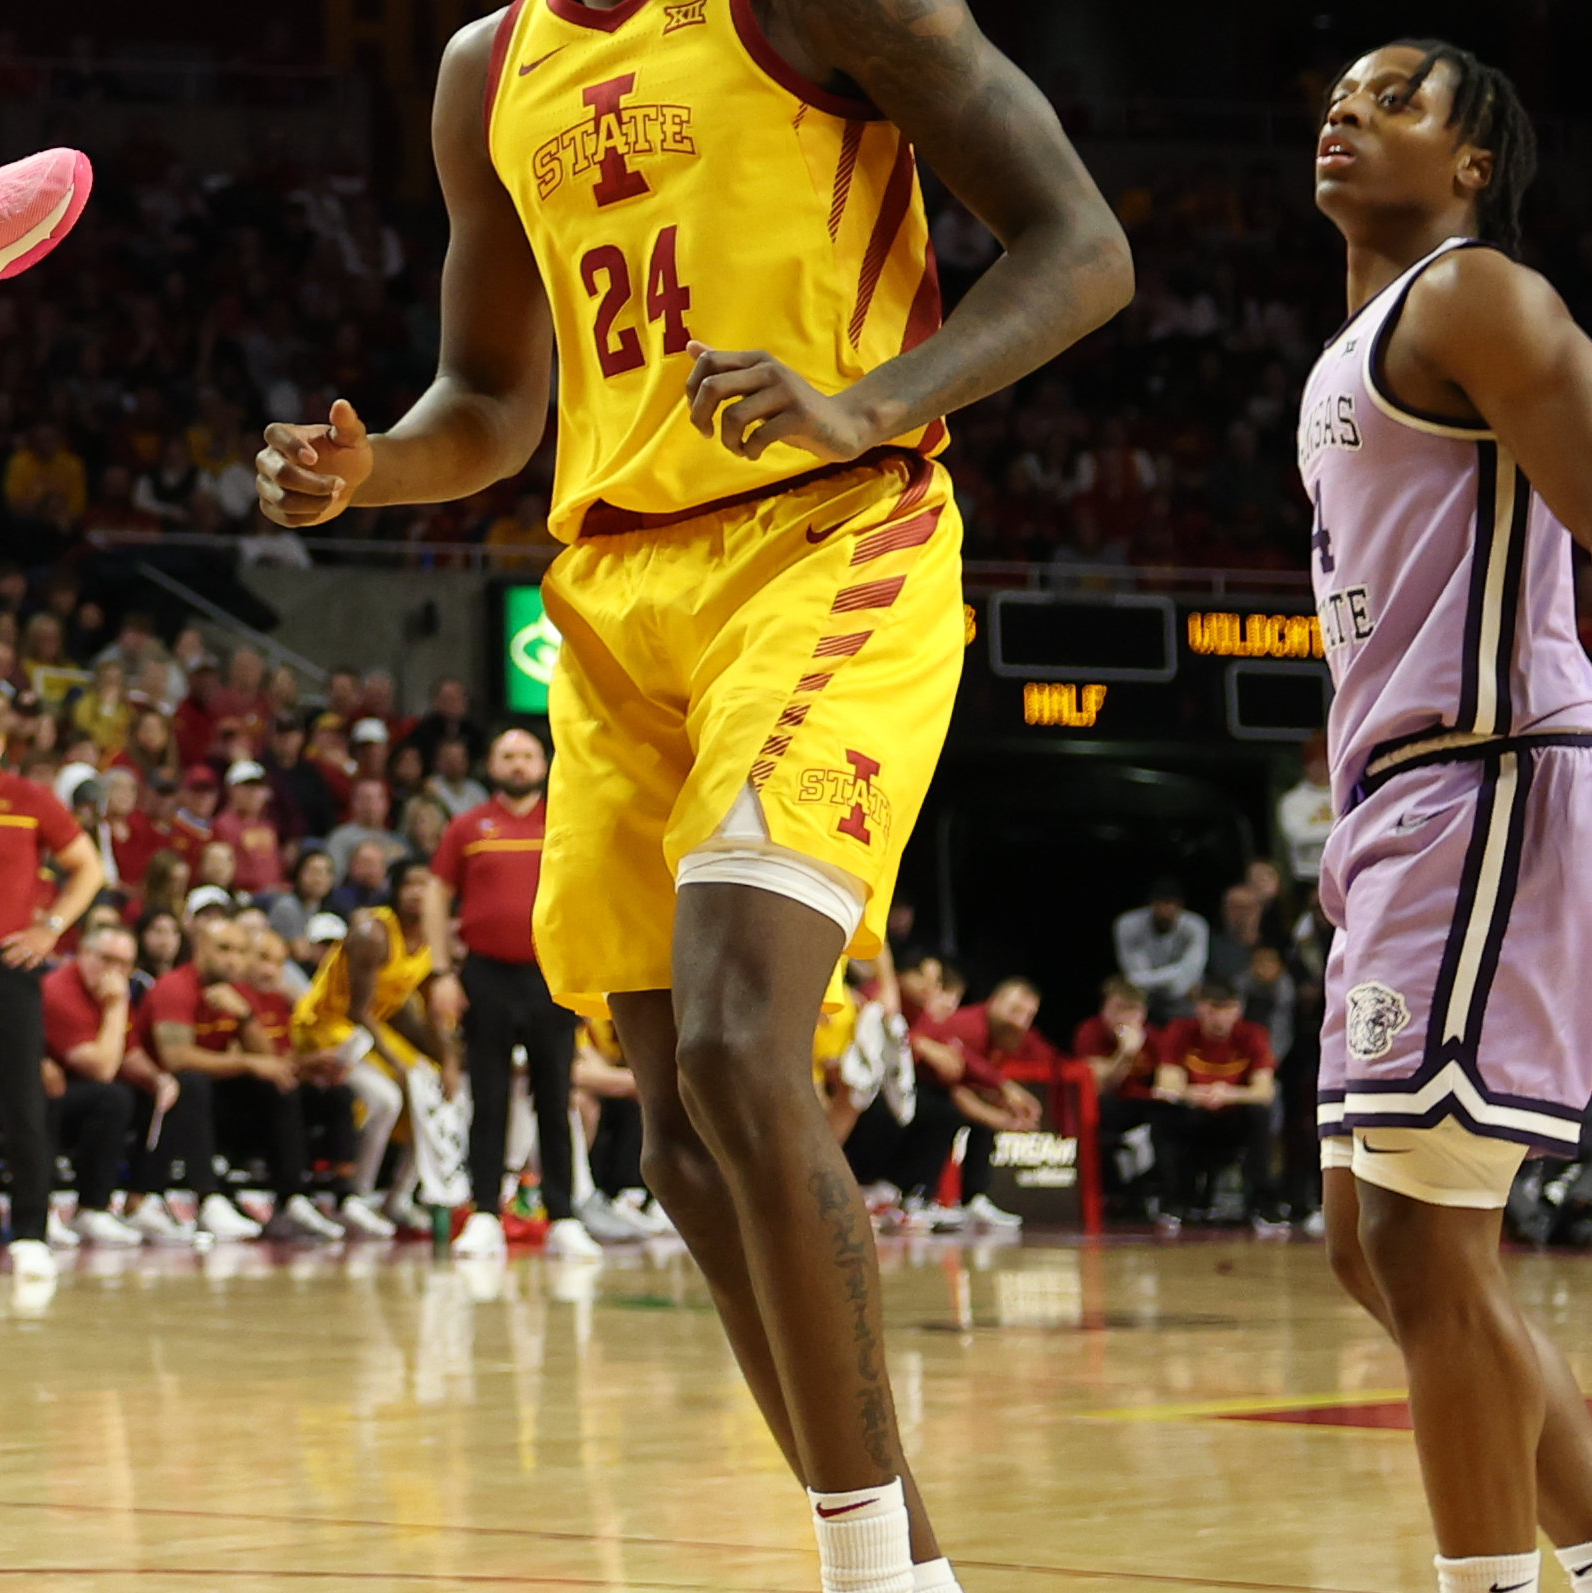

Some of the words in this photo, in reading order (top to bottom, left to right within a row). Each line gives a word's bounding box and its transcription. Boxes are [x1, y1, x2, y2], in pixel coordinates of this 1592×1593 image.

[531, 104, 698, 203] STATE
[580, 225, 692, 380] 24
[1188, 612, 1326, 658] WILDCAT
